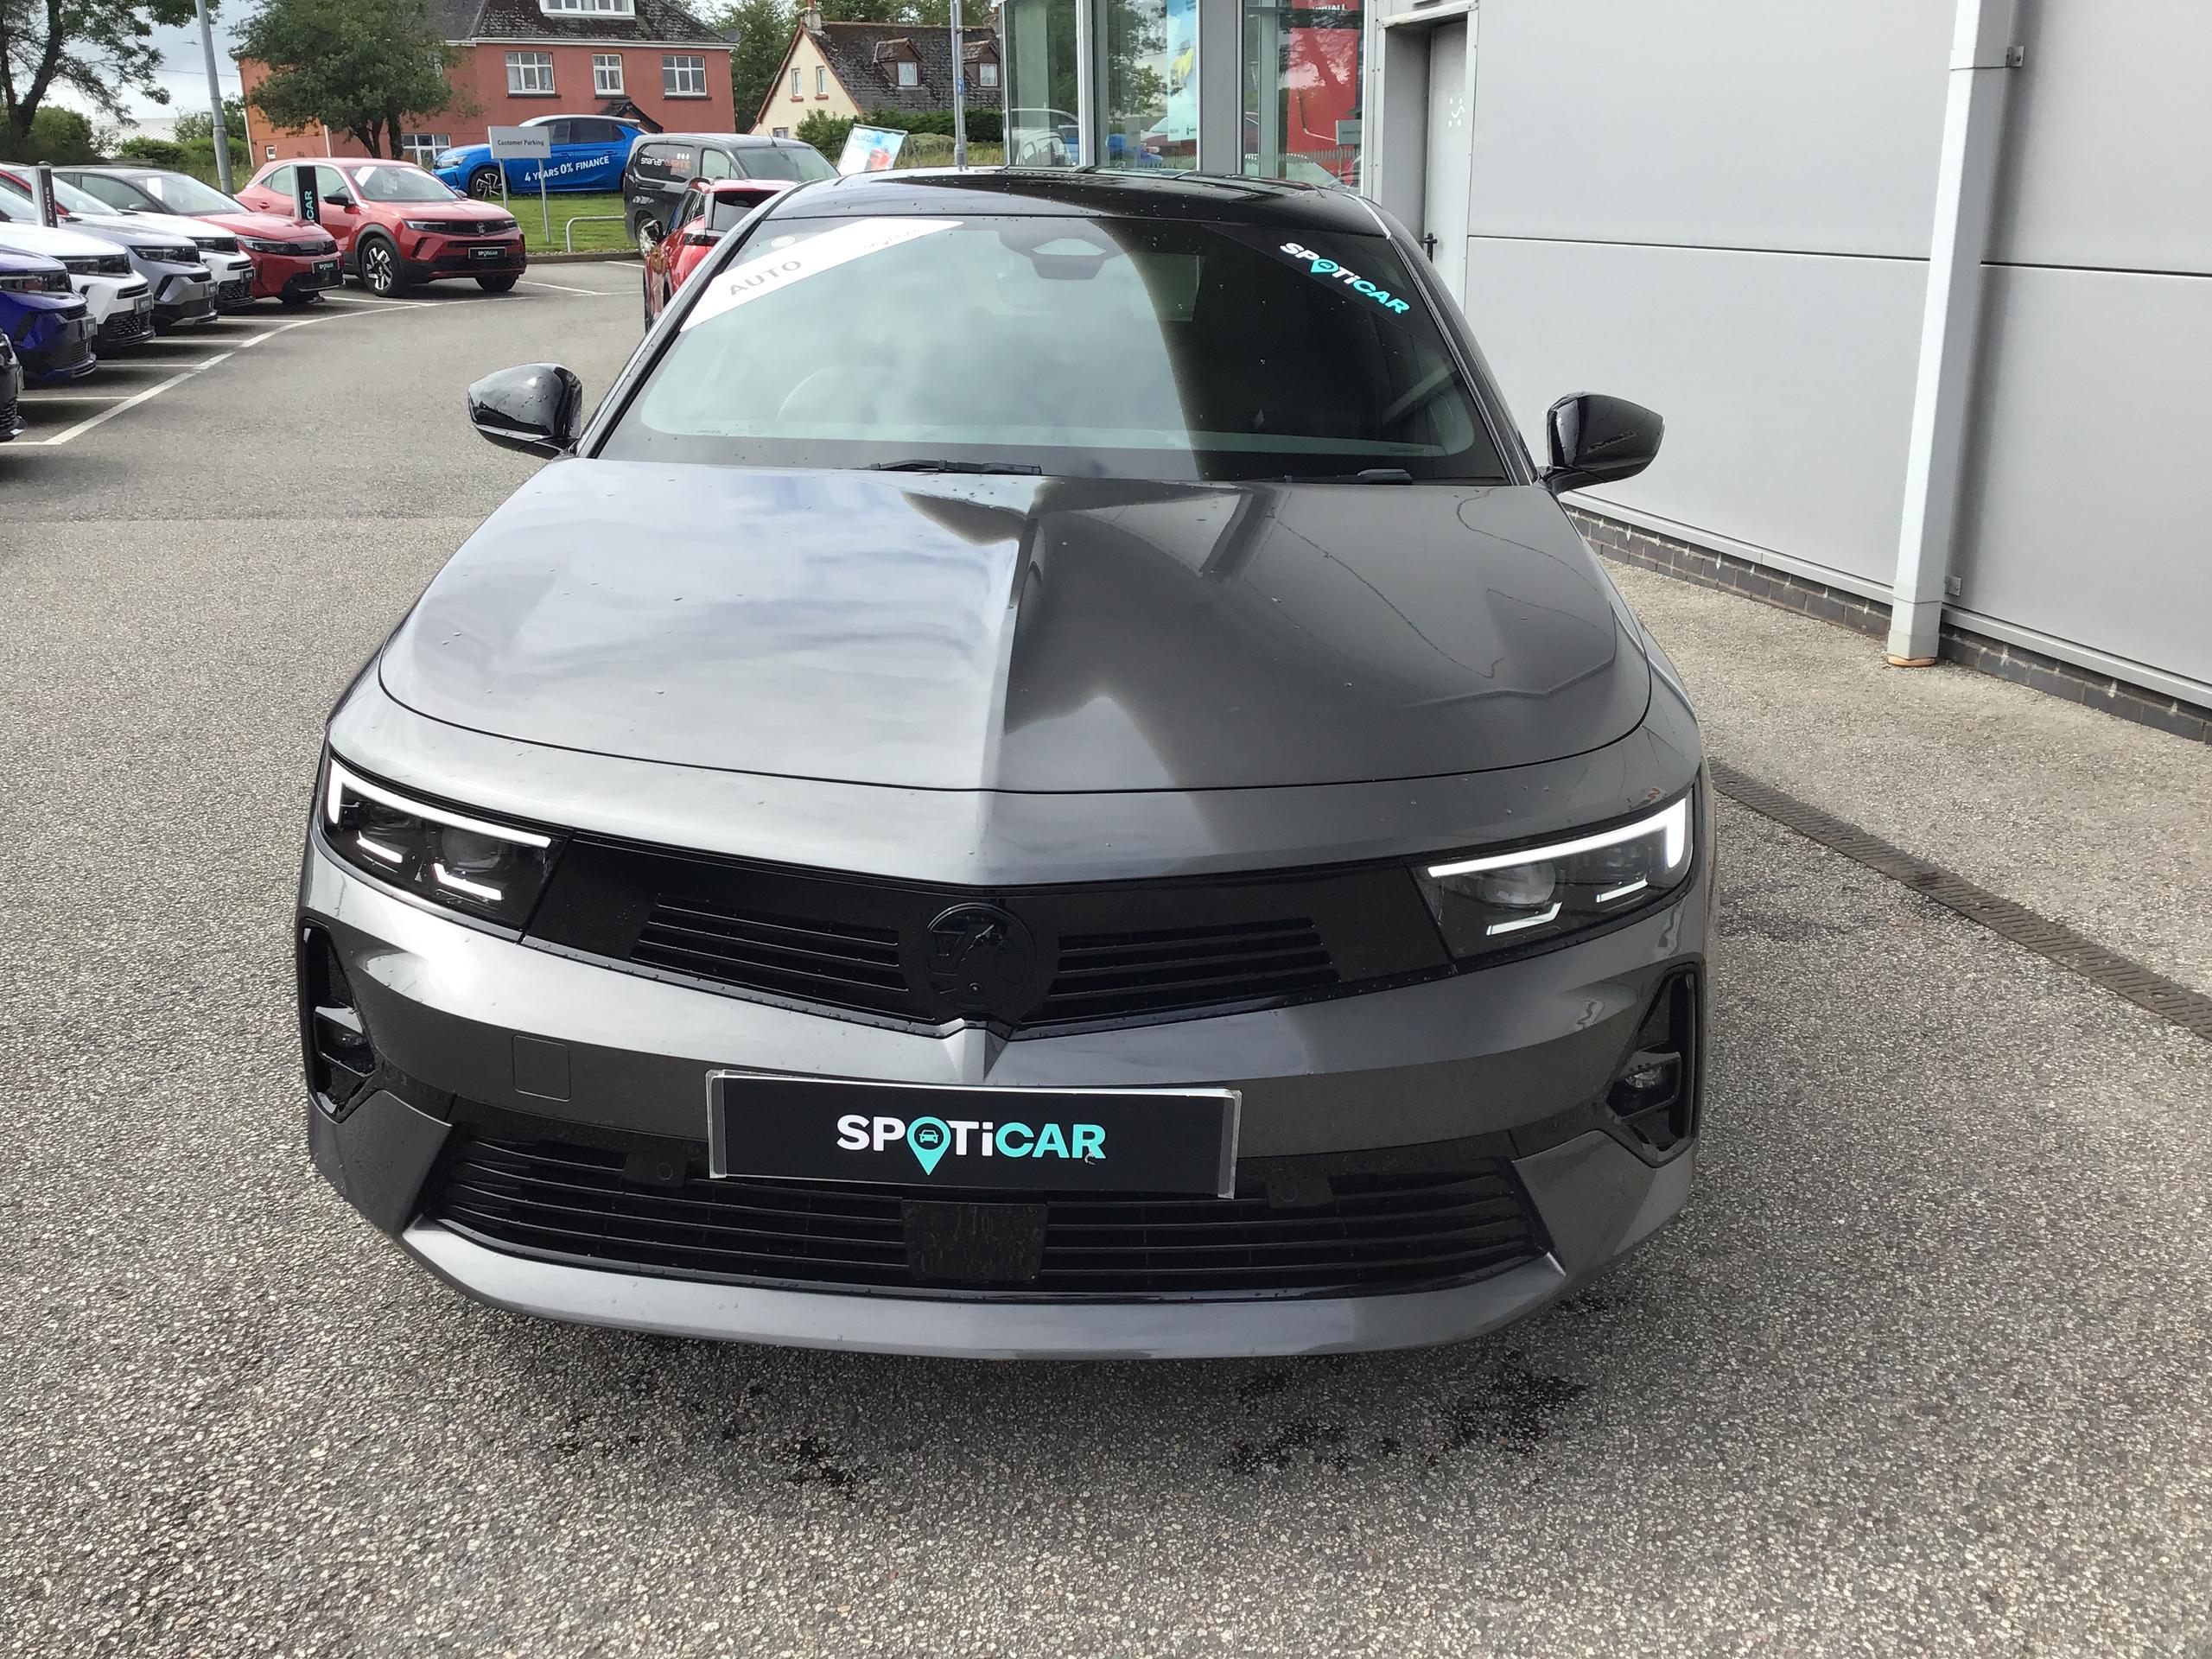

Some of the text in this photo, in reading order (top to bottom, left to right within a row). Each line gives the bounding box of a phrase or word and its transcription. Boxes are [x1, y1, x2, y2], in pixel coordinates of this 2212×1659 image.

[524, 172, 531, 181] 4
[560, 162, 574, 174] 0%
[575, 156, 610, 171] FINANCE
[729, 260, 802, 296] AUTO
